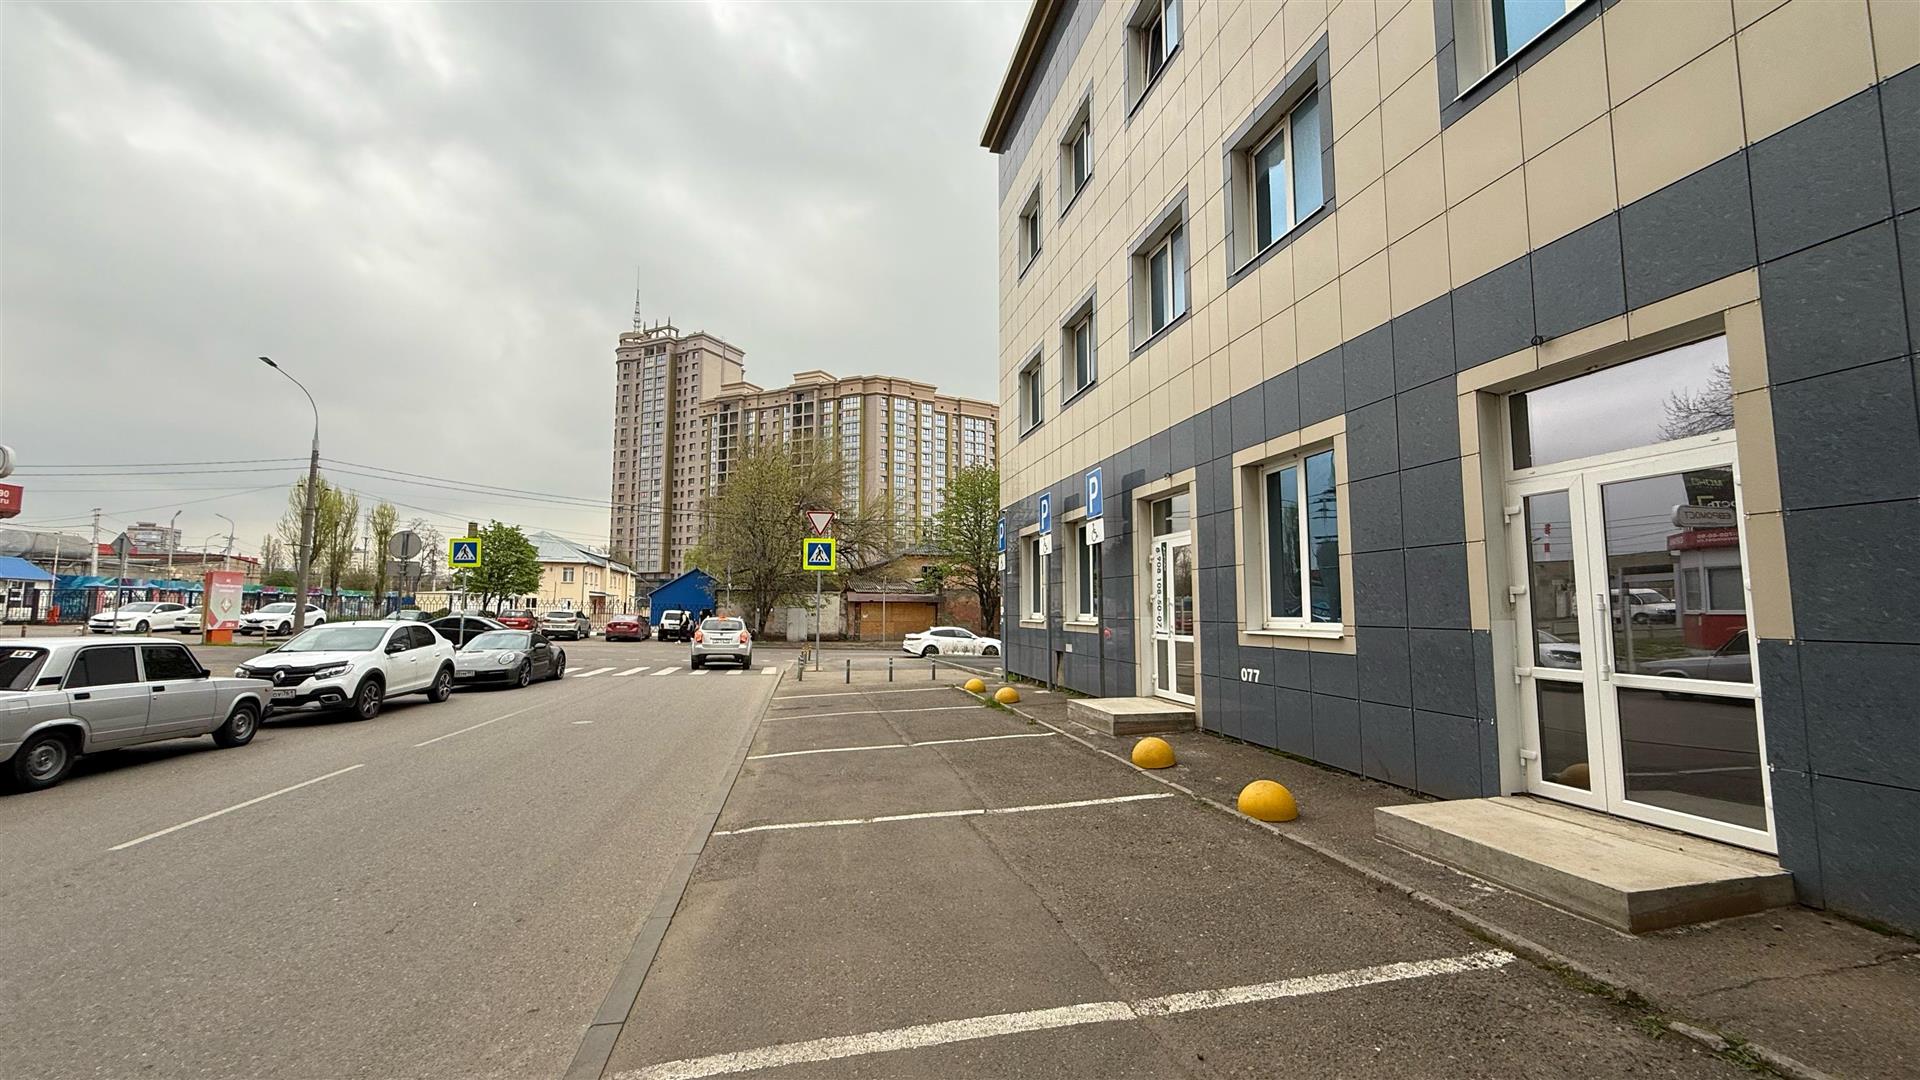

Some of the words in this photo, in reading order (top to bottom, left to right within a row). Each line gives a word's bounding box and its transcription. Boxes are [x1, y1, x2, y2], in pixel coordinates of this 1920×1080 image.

[1089, 476, 1098, 514] P
[1041, 499, 1048, 530] P
[999, 522, 1004, 549] P
[1240, 667, 1260, 683] 077
